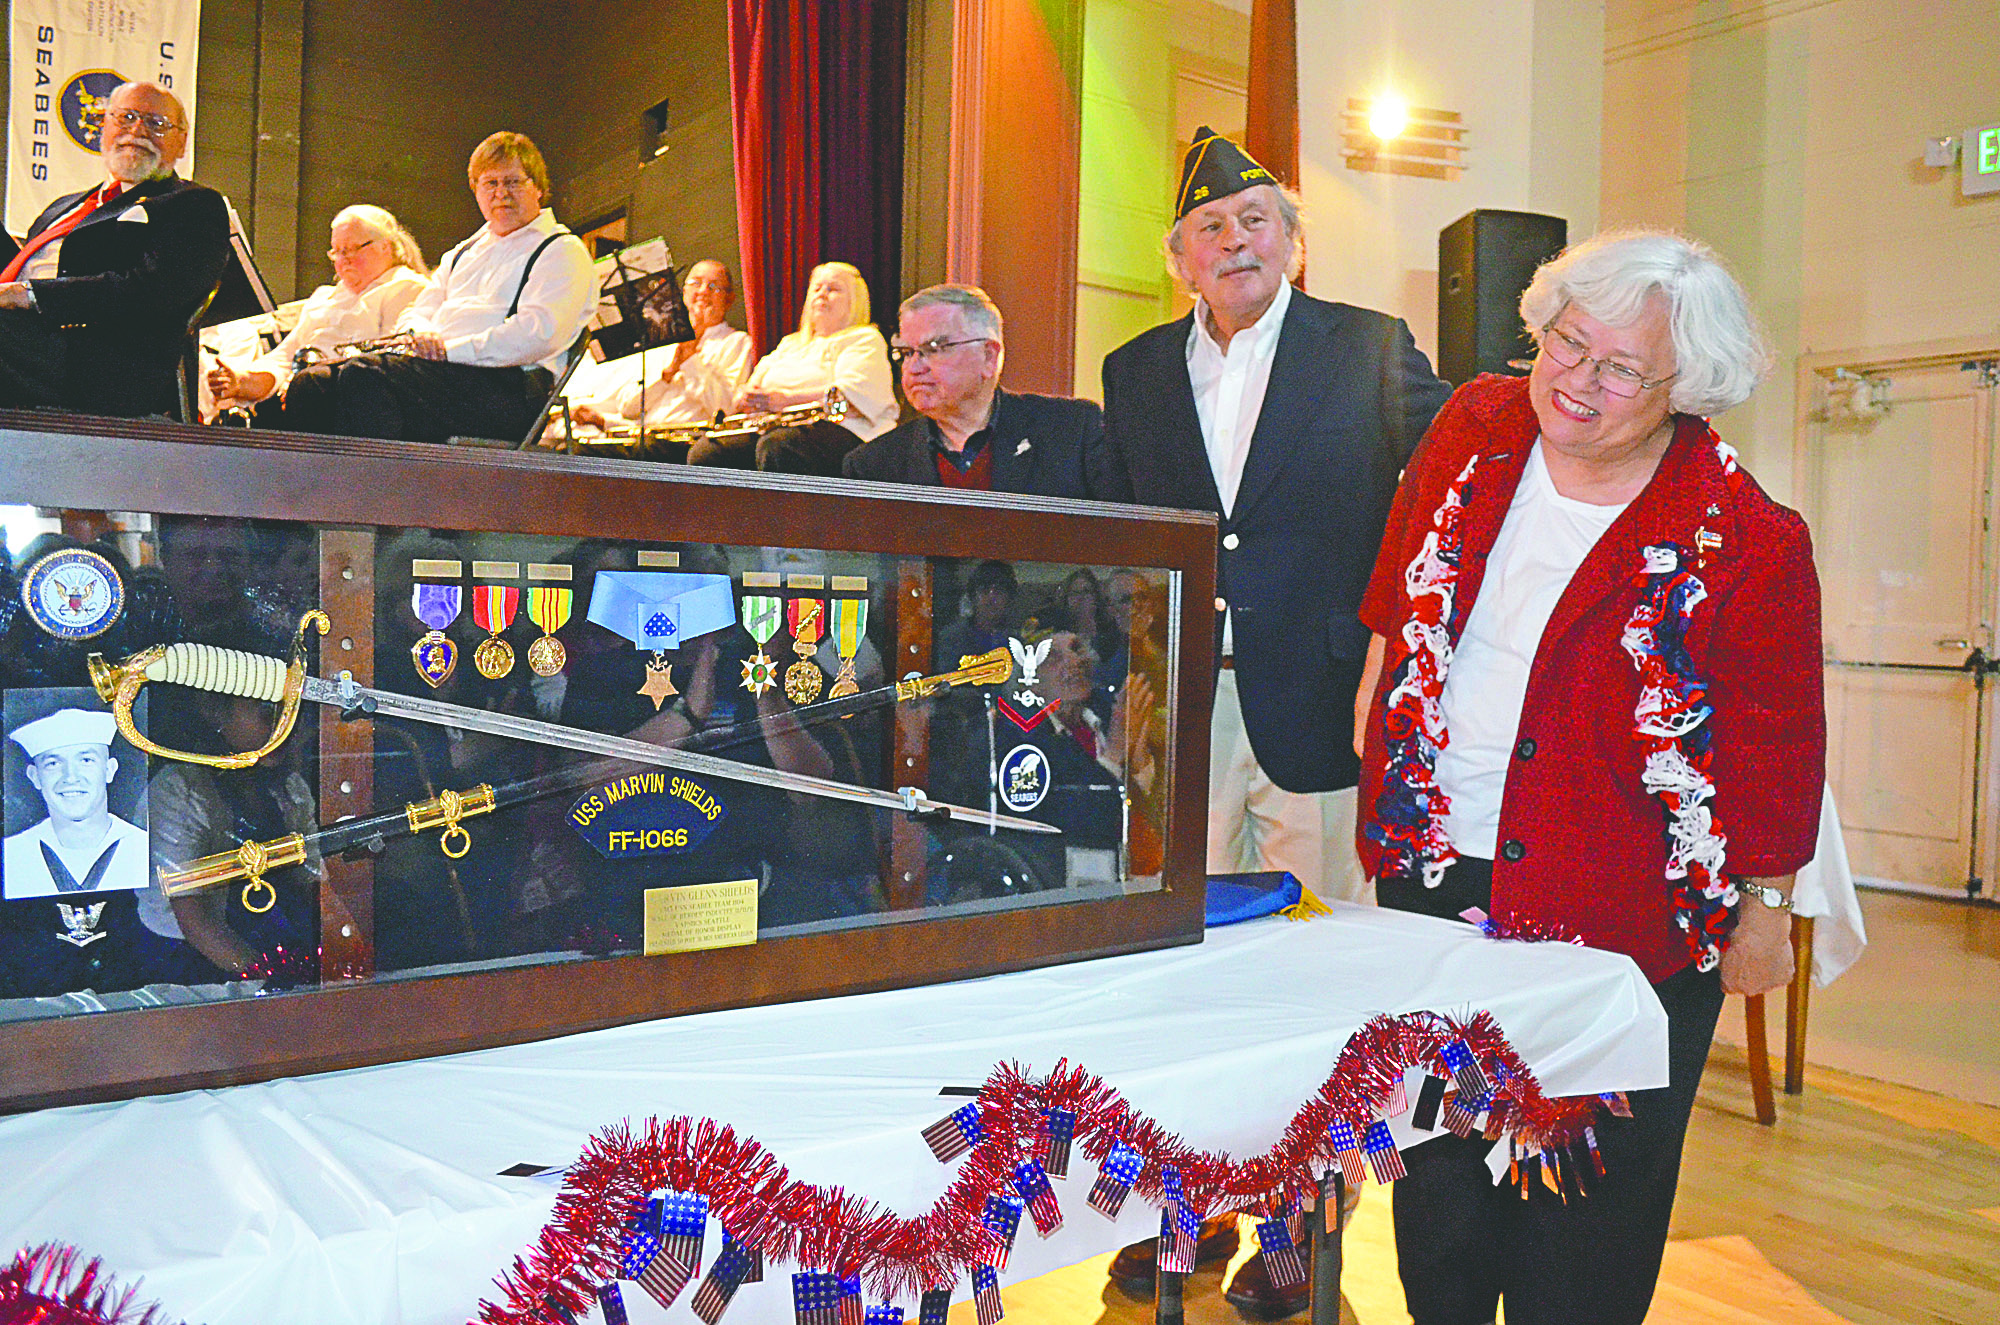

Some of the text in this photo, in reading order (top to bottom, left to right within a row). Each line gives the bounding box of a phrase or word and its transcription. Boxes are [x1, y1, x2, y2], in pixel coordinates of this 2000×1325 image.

[32, 26, 54, 181] SEABEES
[572, 773, 722, 826] USS MARVIN SHIELDS
[609, 828, 688, 851] FF-1066
[719, 885, 755, 898] SHIELDS
